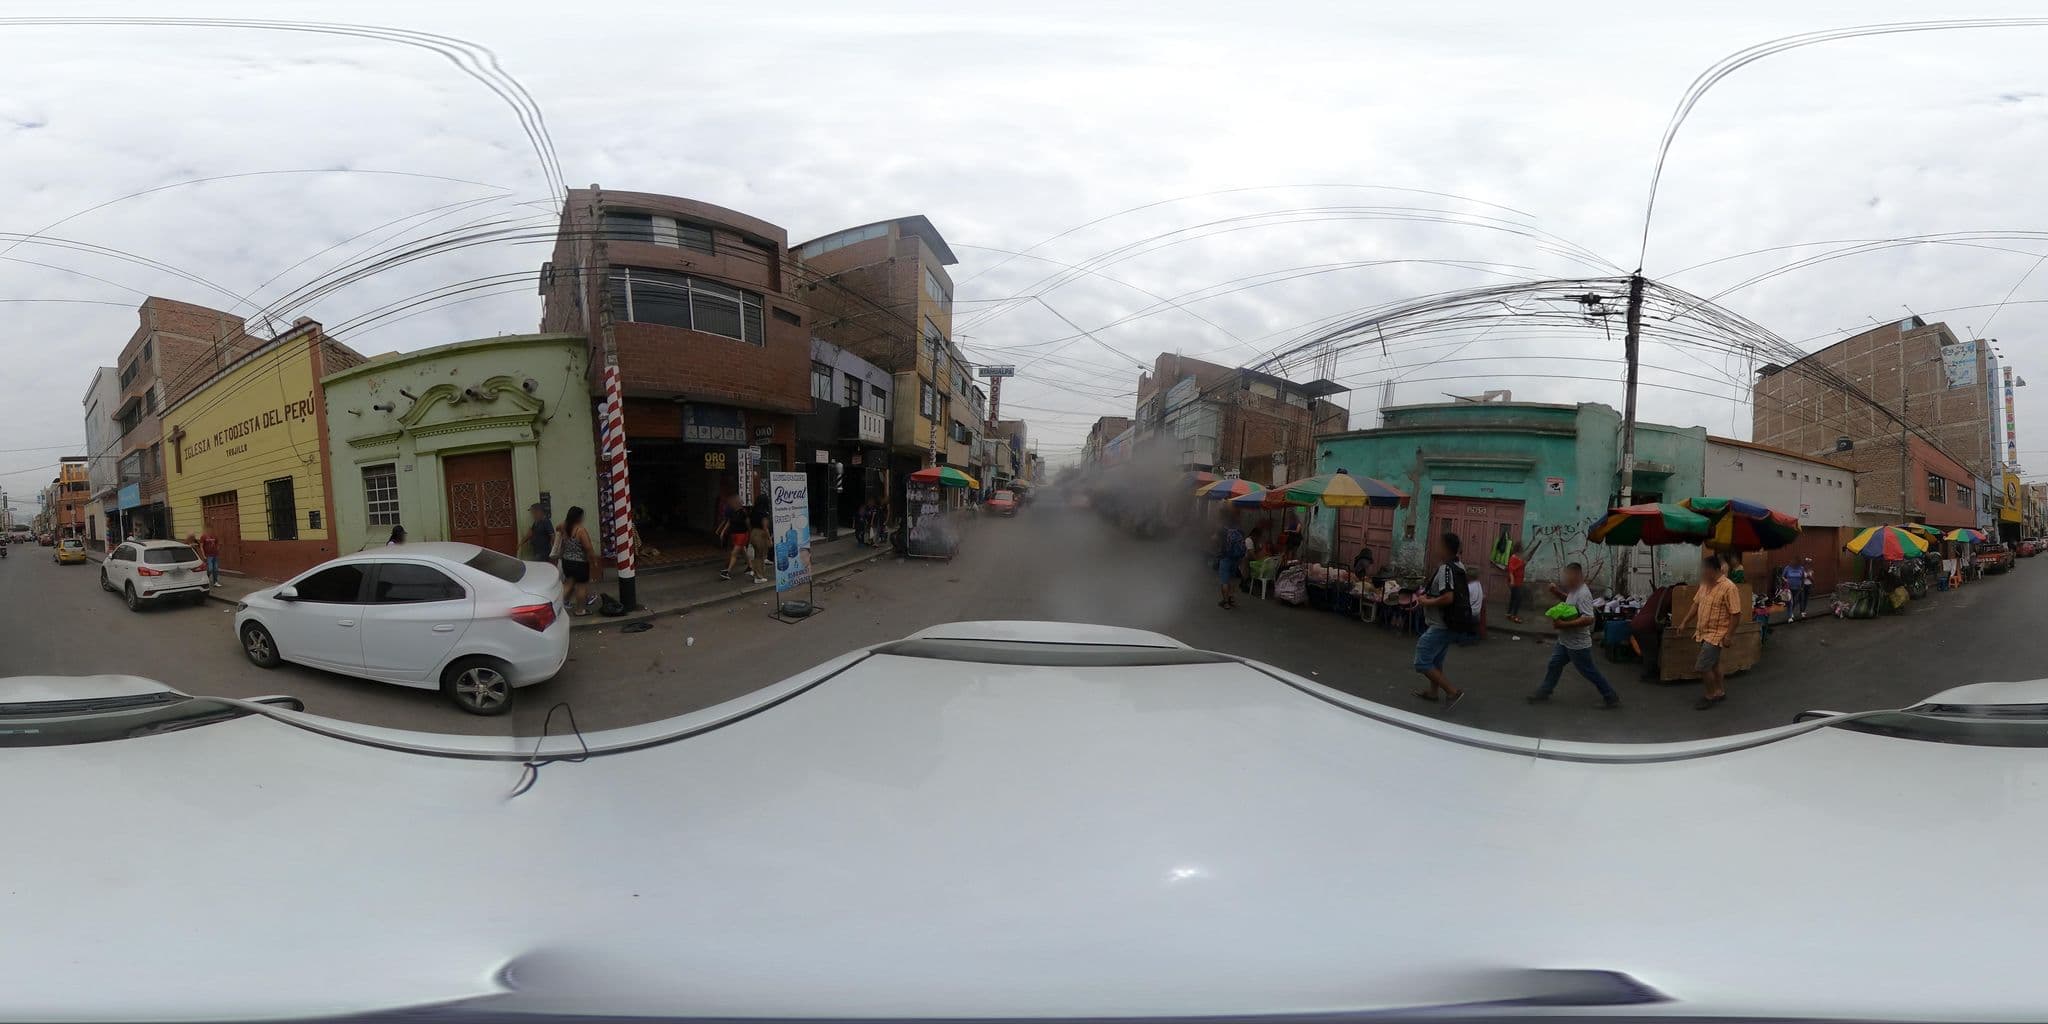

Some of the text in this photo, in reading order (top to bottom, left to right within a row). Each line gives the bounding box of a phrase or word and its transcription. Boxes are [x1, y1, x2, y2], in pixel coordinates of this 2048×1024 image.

[990, 377, 1000, 430] HOSTAL
[184, 391, 315, 460] IGLESIA METODISTA DEL PERÚ
[225, 444, 248, 458] TRUJILLO
[704, 452, 726, 462] ORO
[774, 486, 806, 505] Boreal
